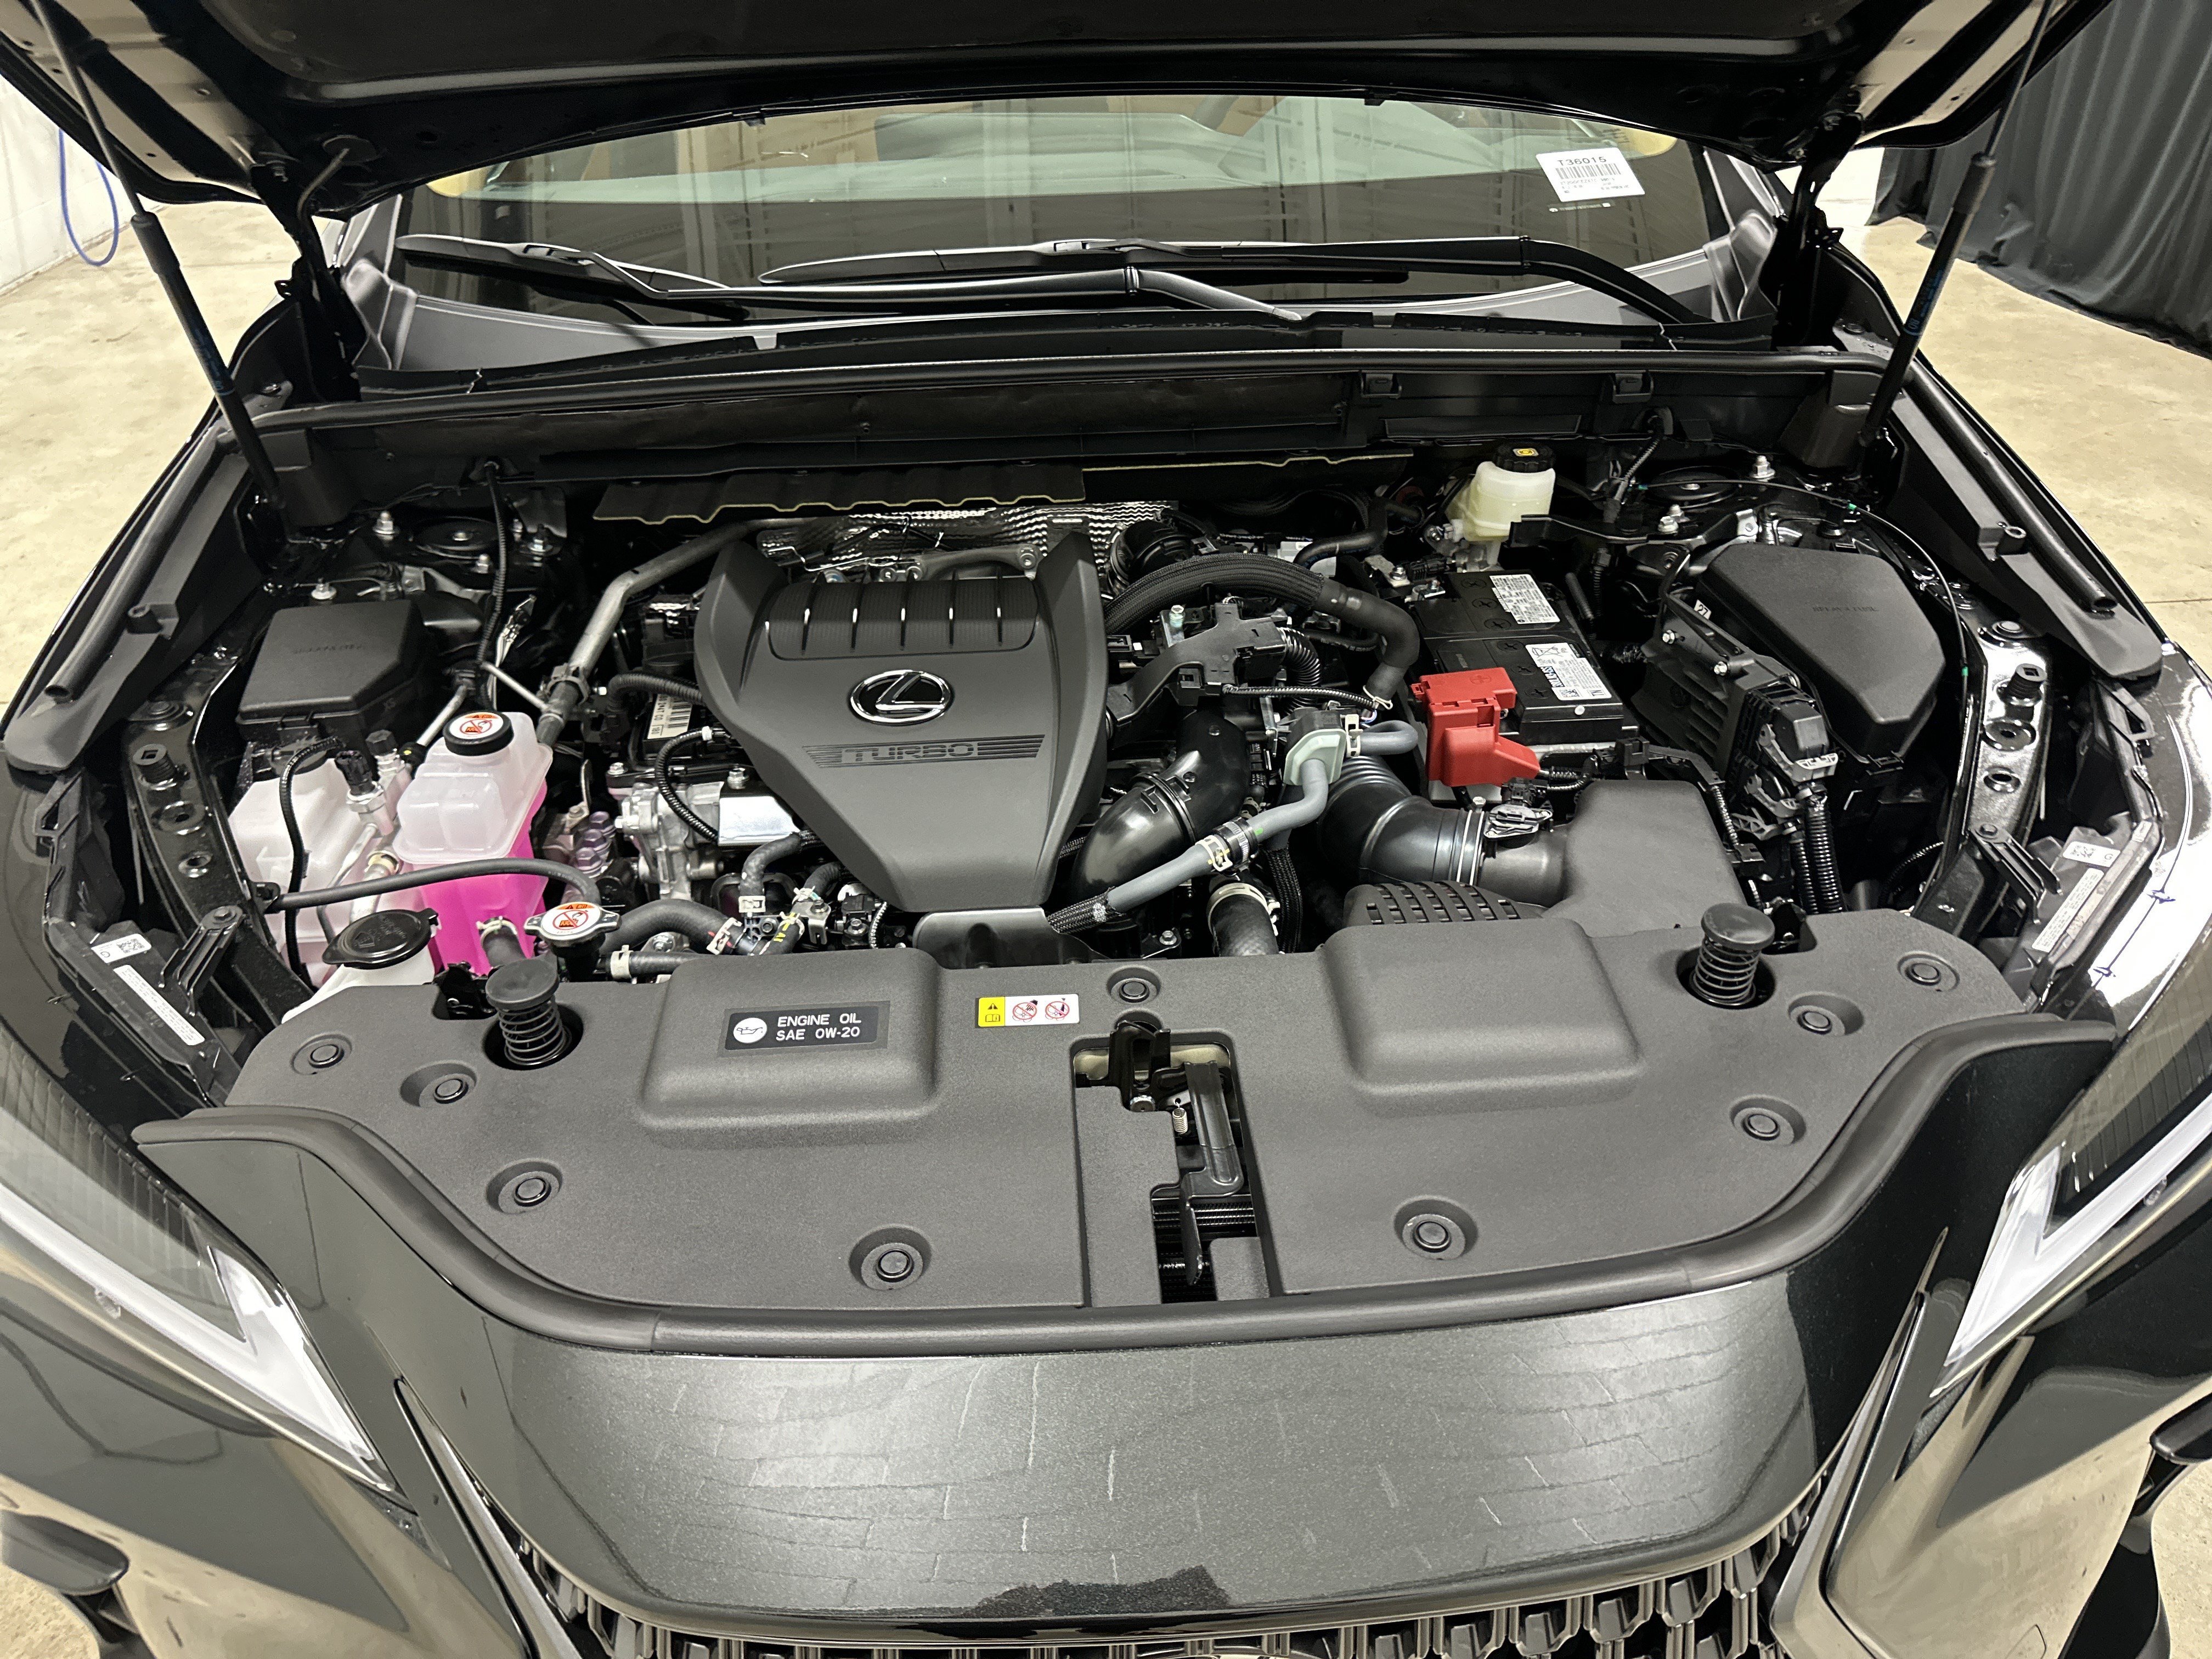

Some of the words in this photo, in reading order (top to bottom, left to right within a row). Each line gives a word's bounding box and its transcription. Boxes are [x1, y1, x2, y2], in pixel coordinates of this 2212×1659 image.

[1557, 156, 1607, 166] T36015
[1697, 604, 1708, 616] 27
[845, 743, 974, 762] TURBO
[777, 1014, 830, 1028] ENGINE
[839, 1013, 862, 1024] OIL
[776, 1029, 806, 1041] SAE
[815, 1026, 861, 1039] 0W-20
